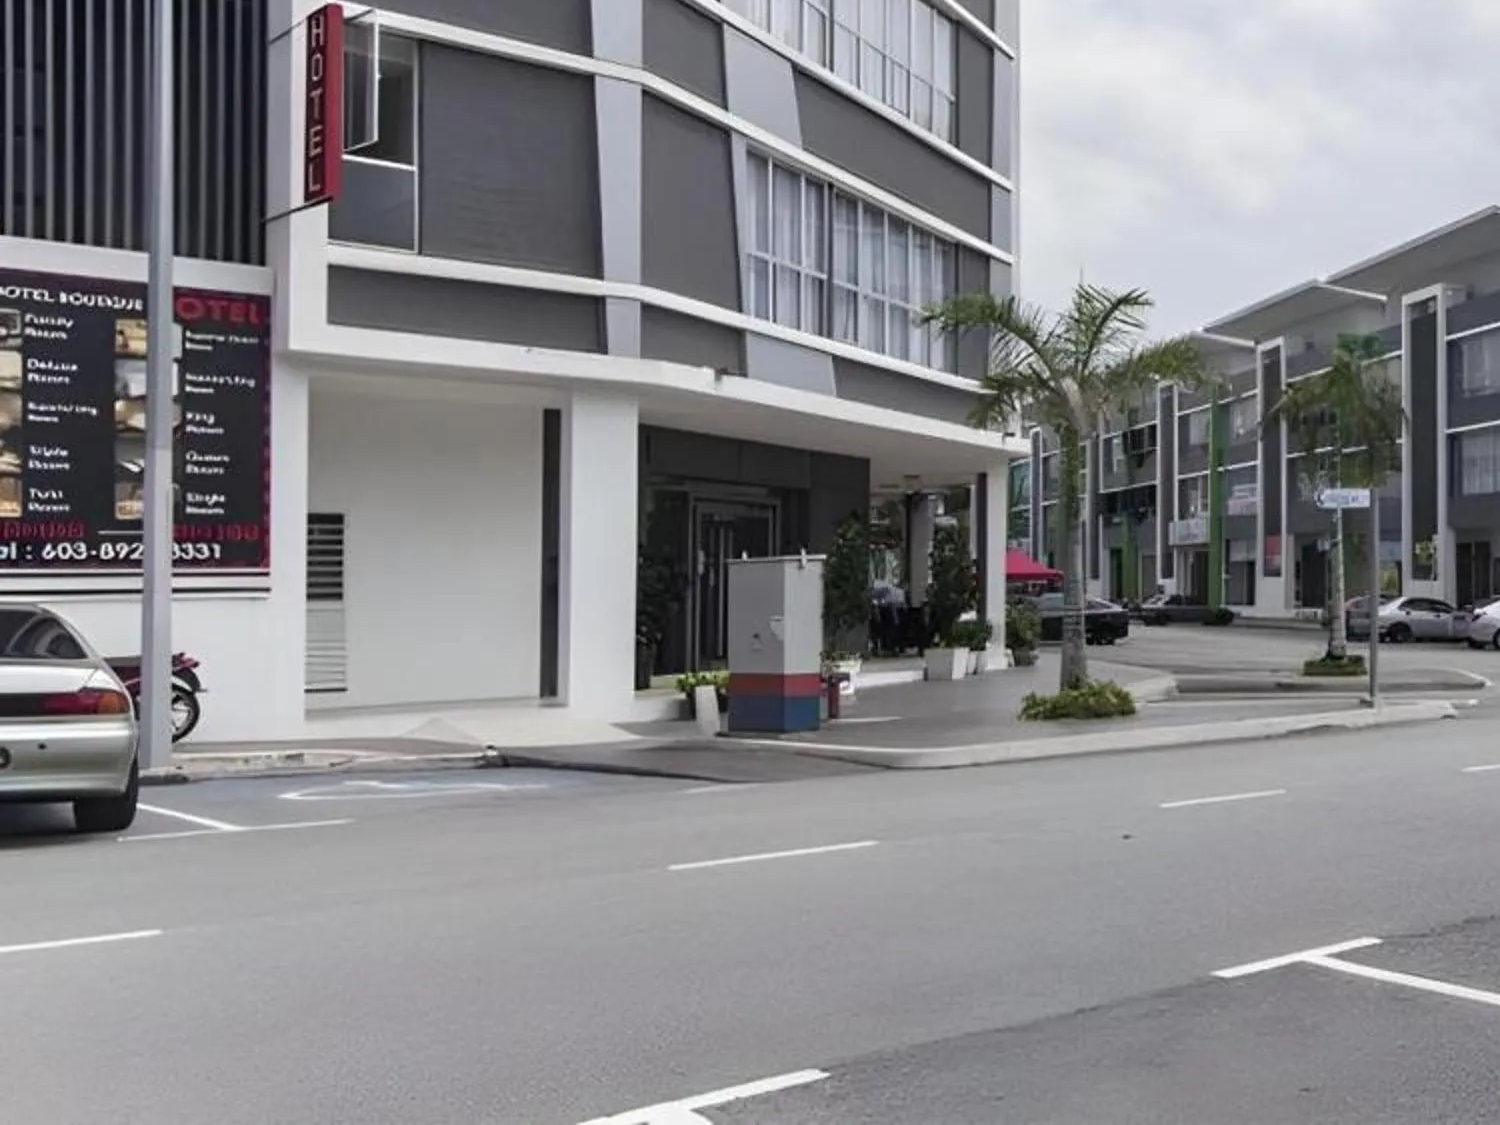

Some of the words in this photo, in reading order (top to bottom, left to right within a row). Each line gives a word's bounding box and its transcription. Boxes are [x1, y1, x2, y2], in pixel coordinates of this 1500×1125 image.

[308, 15, 325, 192] HOTEL
[174, 296, 260, 324] OTEL
[41, 542, 144, 560] 603-892
